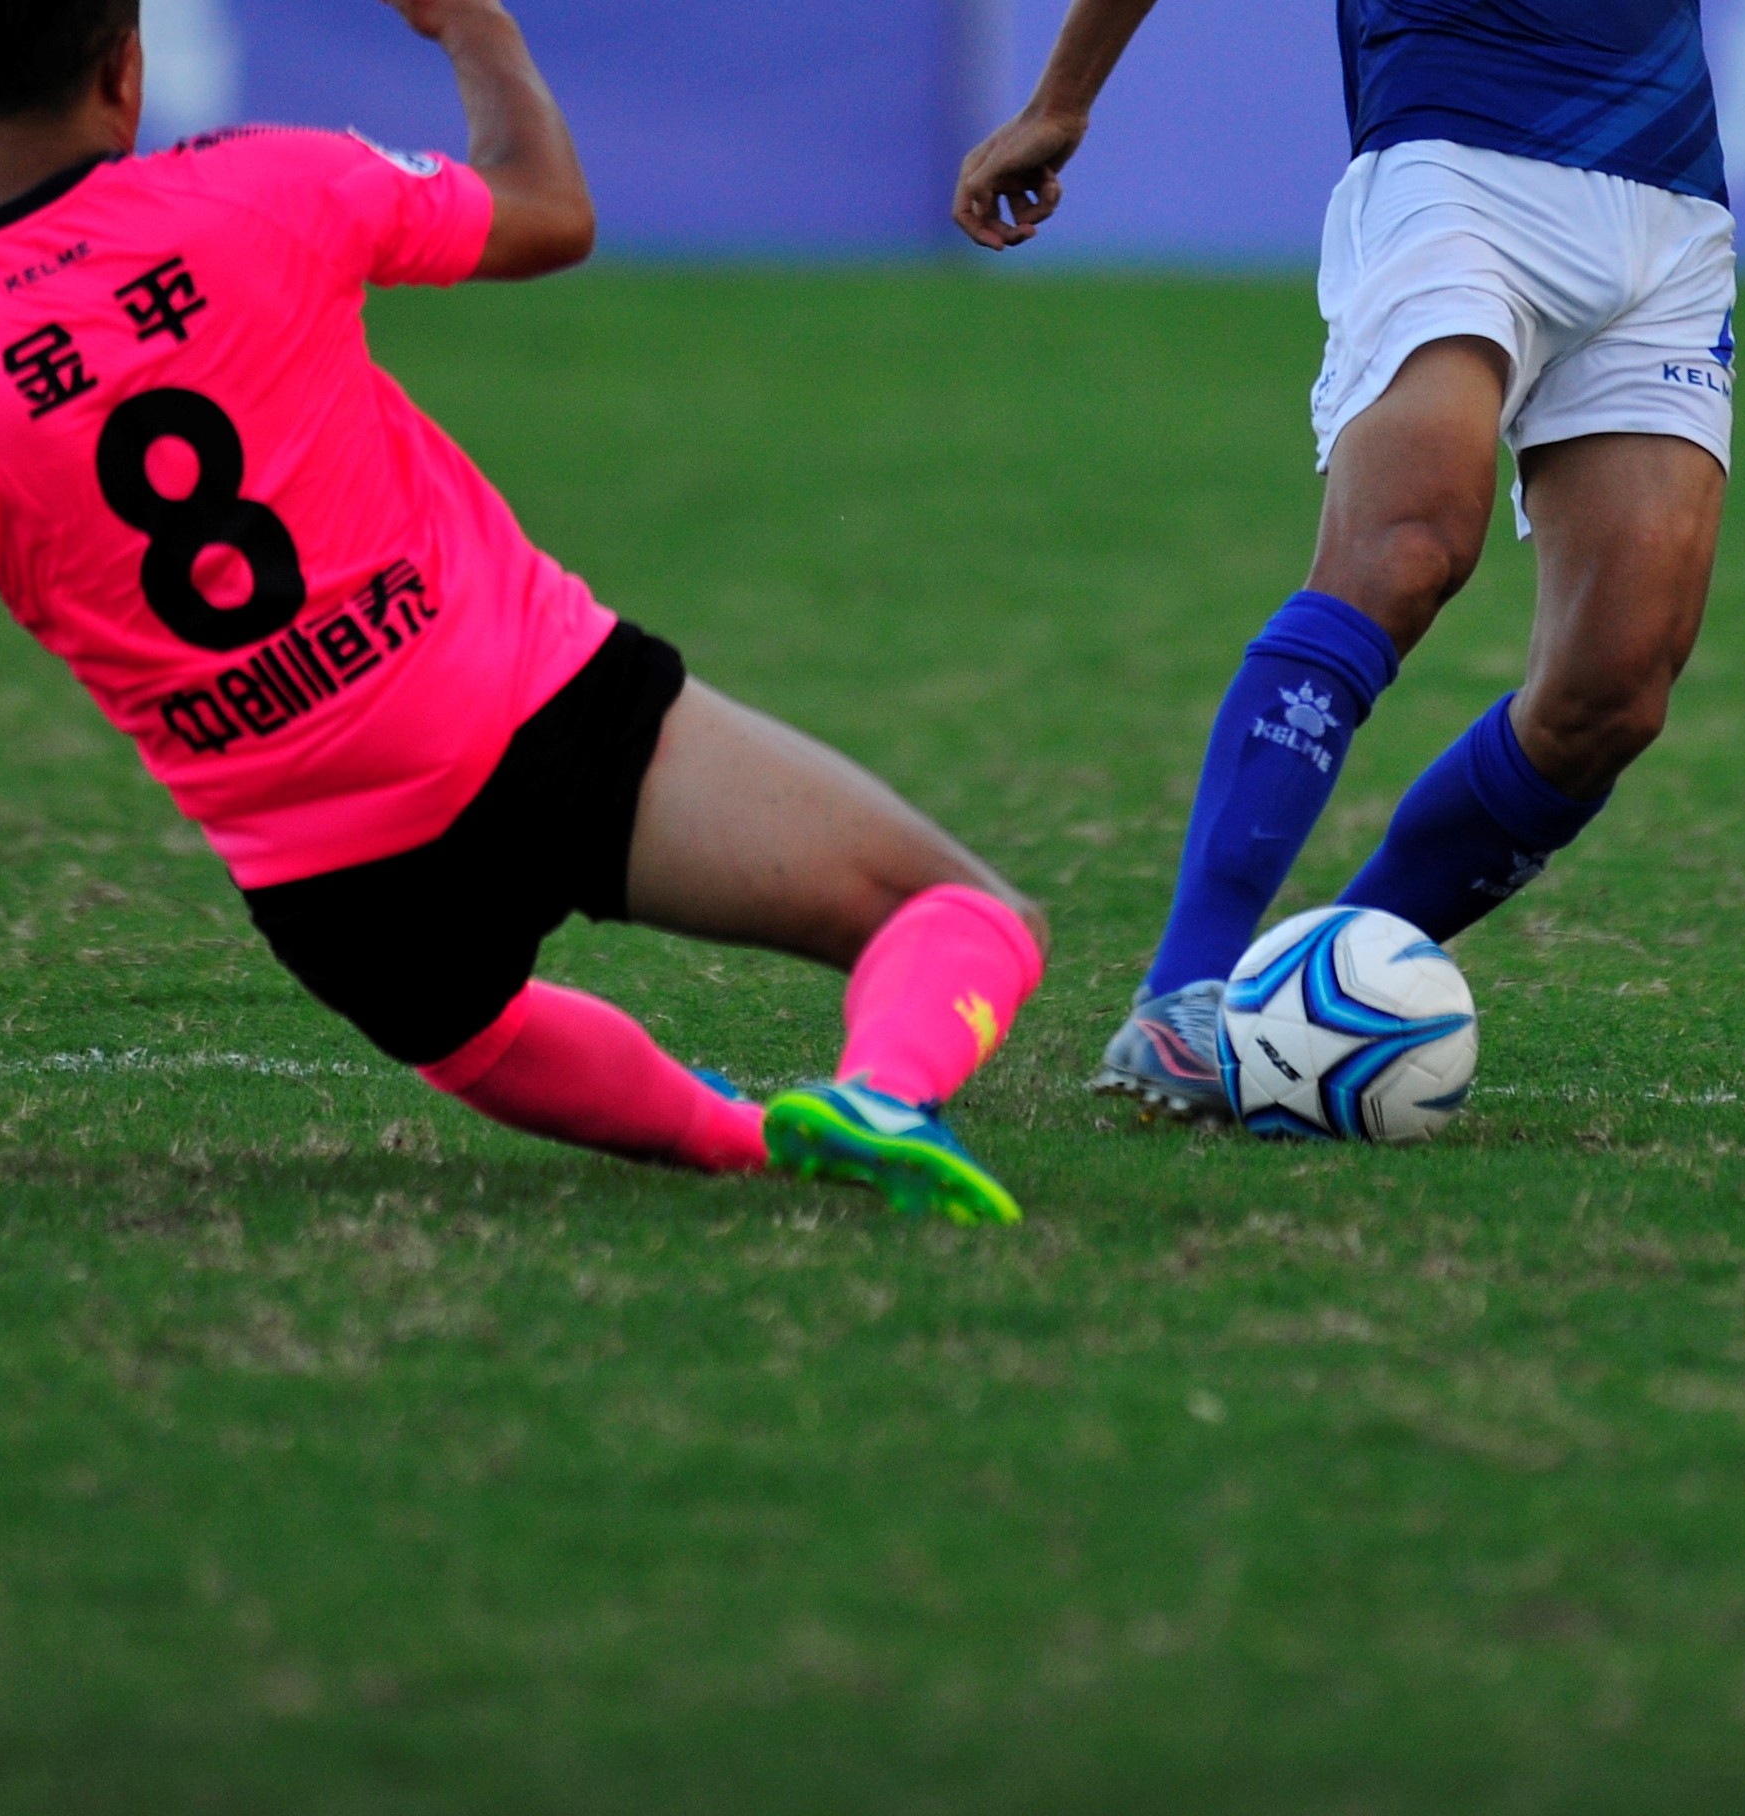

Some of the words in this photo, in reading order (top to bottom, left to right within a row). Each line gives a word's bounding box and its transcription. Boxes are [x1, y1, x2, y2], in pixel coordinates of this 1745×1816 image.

[6, 241, 90, 292] KELME
[96, 387, 307, 652] 8
[1253, 717, 1333, 774] KELME
